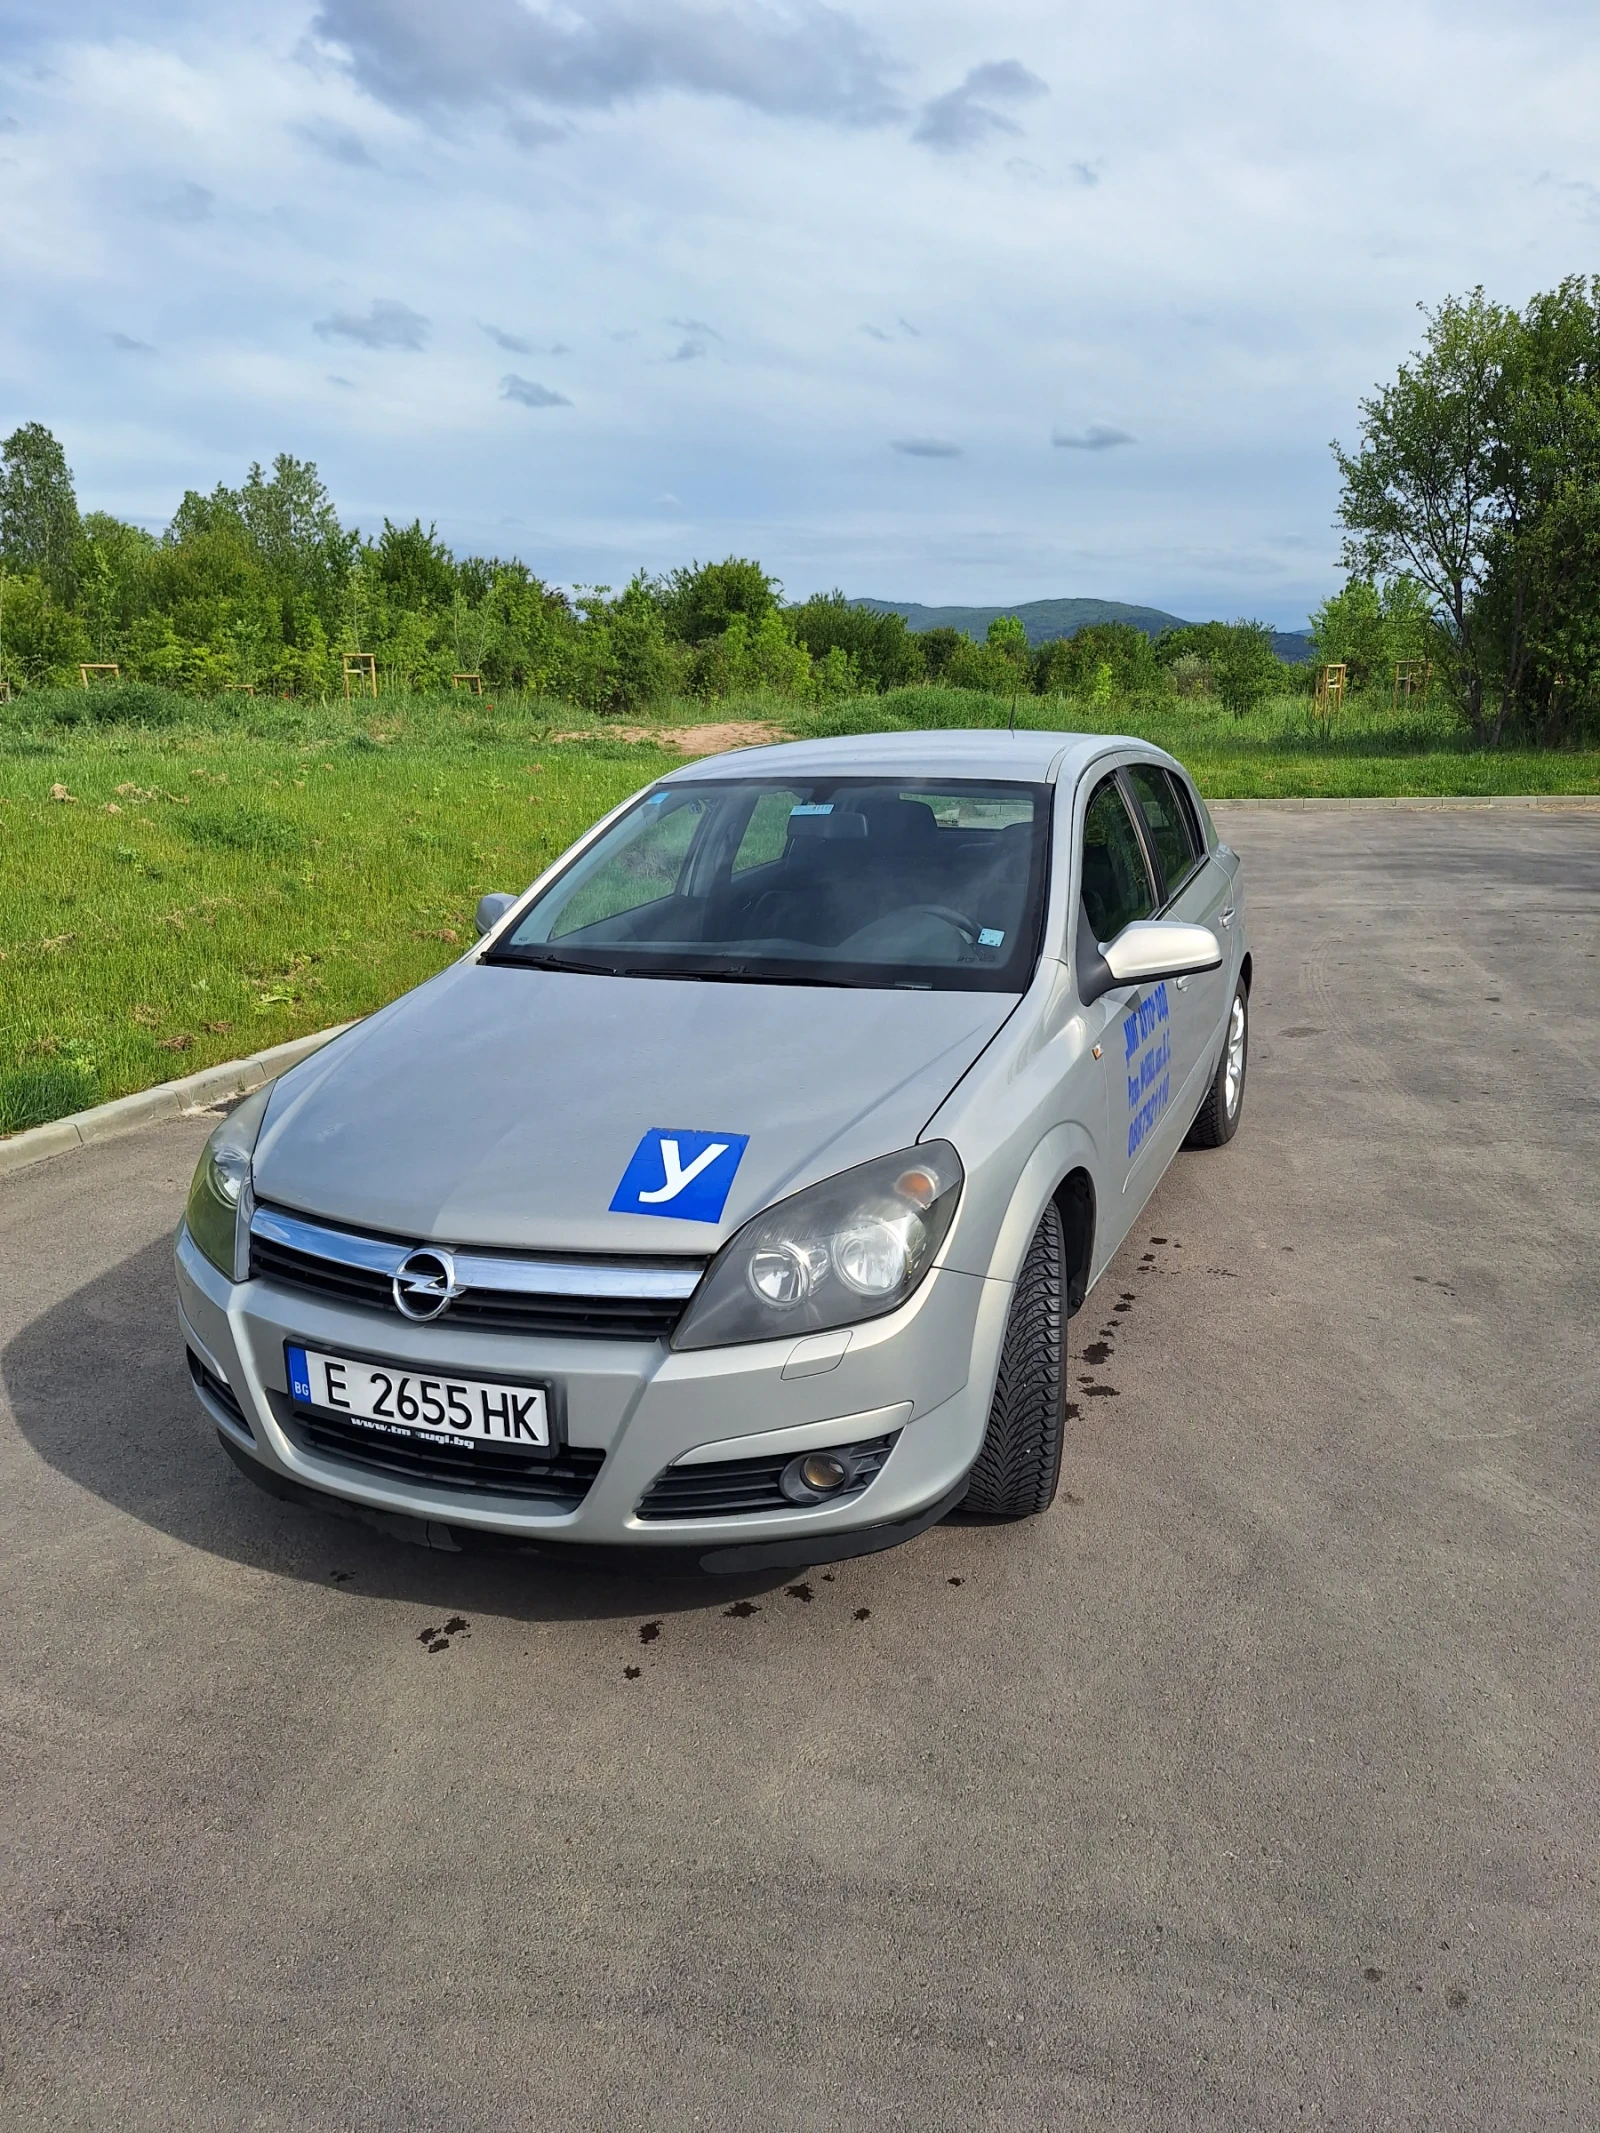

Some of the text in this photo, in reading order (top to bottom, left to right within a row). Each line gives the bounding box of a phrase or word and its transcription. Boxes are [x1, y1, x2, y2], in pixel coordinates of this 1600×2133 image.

[294, 1381, 309, 1397] BG
[324, 1361, 350, 1408] E
[370, 1372, 472, 1430] 2655
